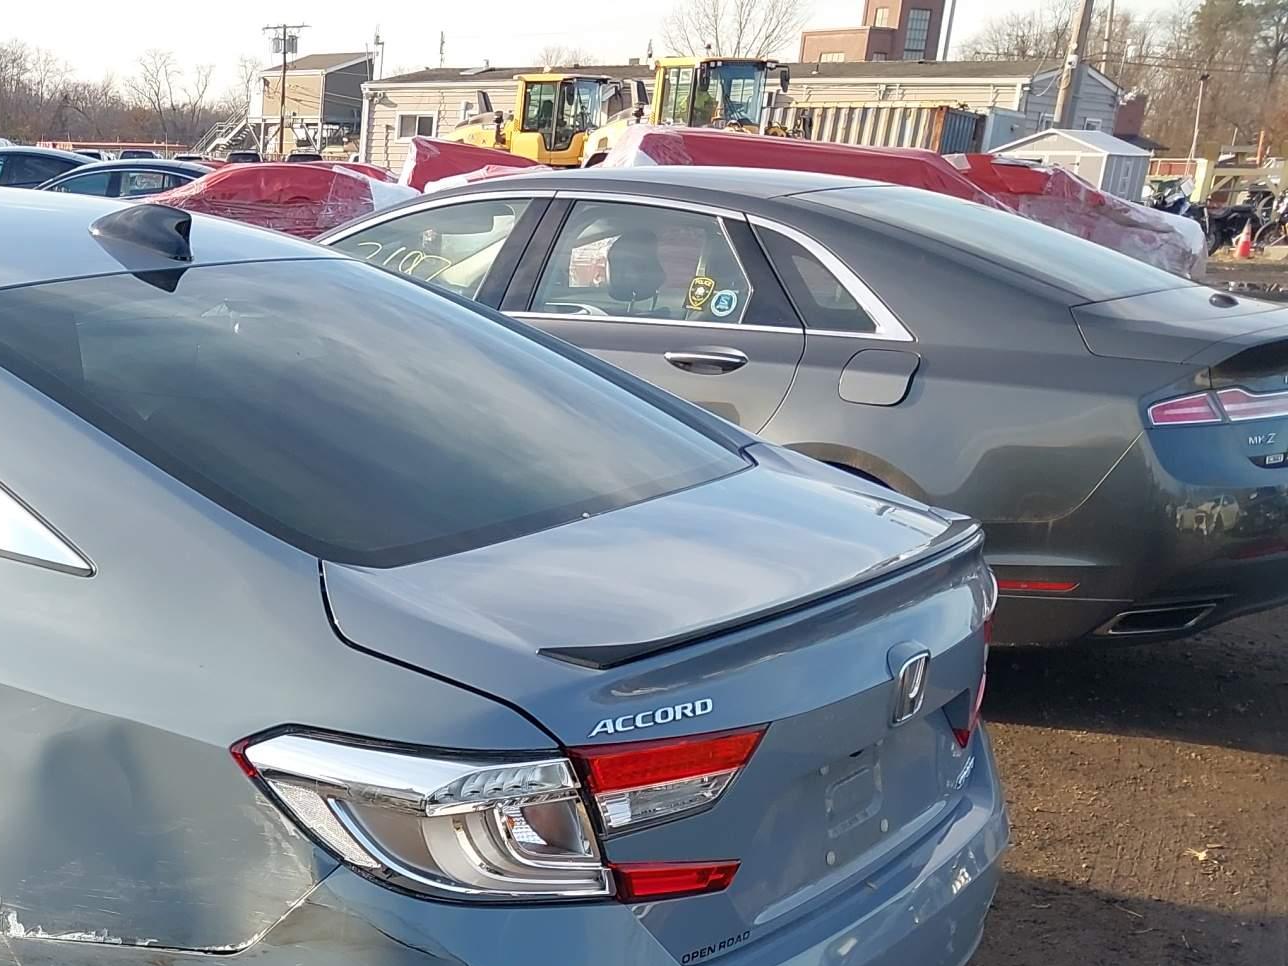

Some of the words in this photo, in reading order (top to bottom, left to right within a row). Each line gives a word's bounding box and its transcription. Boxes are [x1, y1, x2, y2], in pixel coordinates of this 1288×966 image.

[1248, 432, 1276, 445] MKZ
[587, 698, 713, 738] ACCORD
[681, 944, 716, 964] OPEN
[718, 930, 751, 951] ROAD
